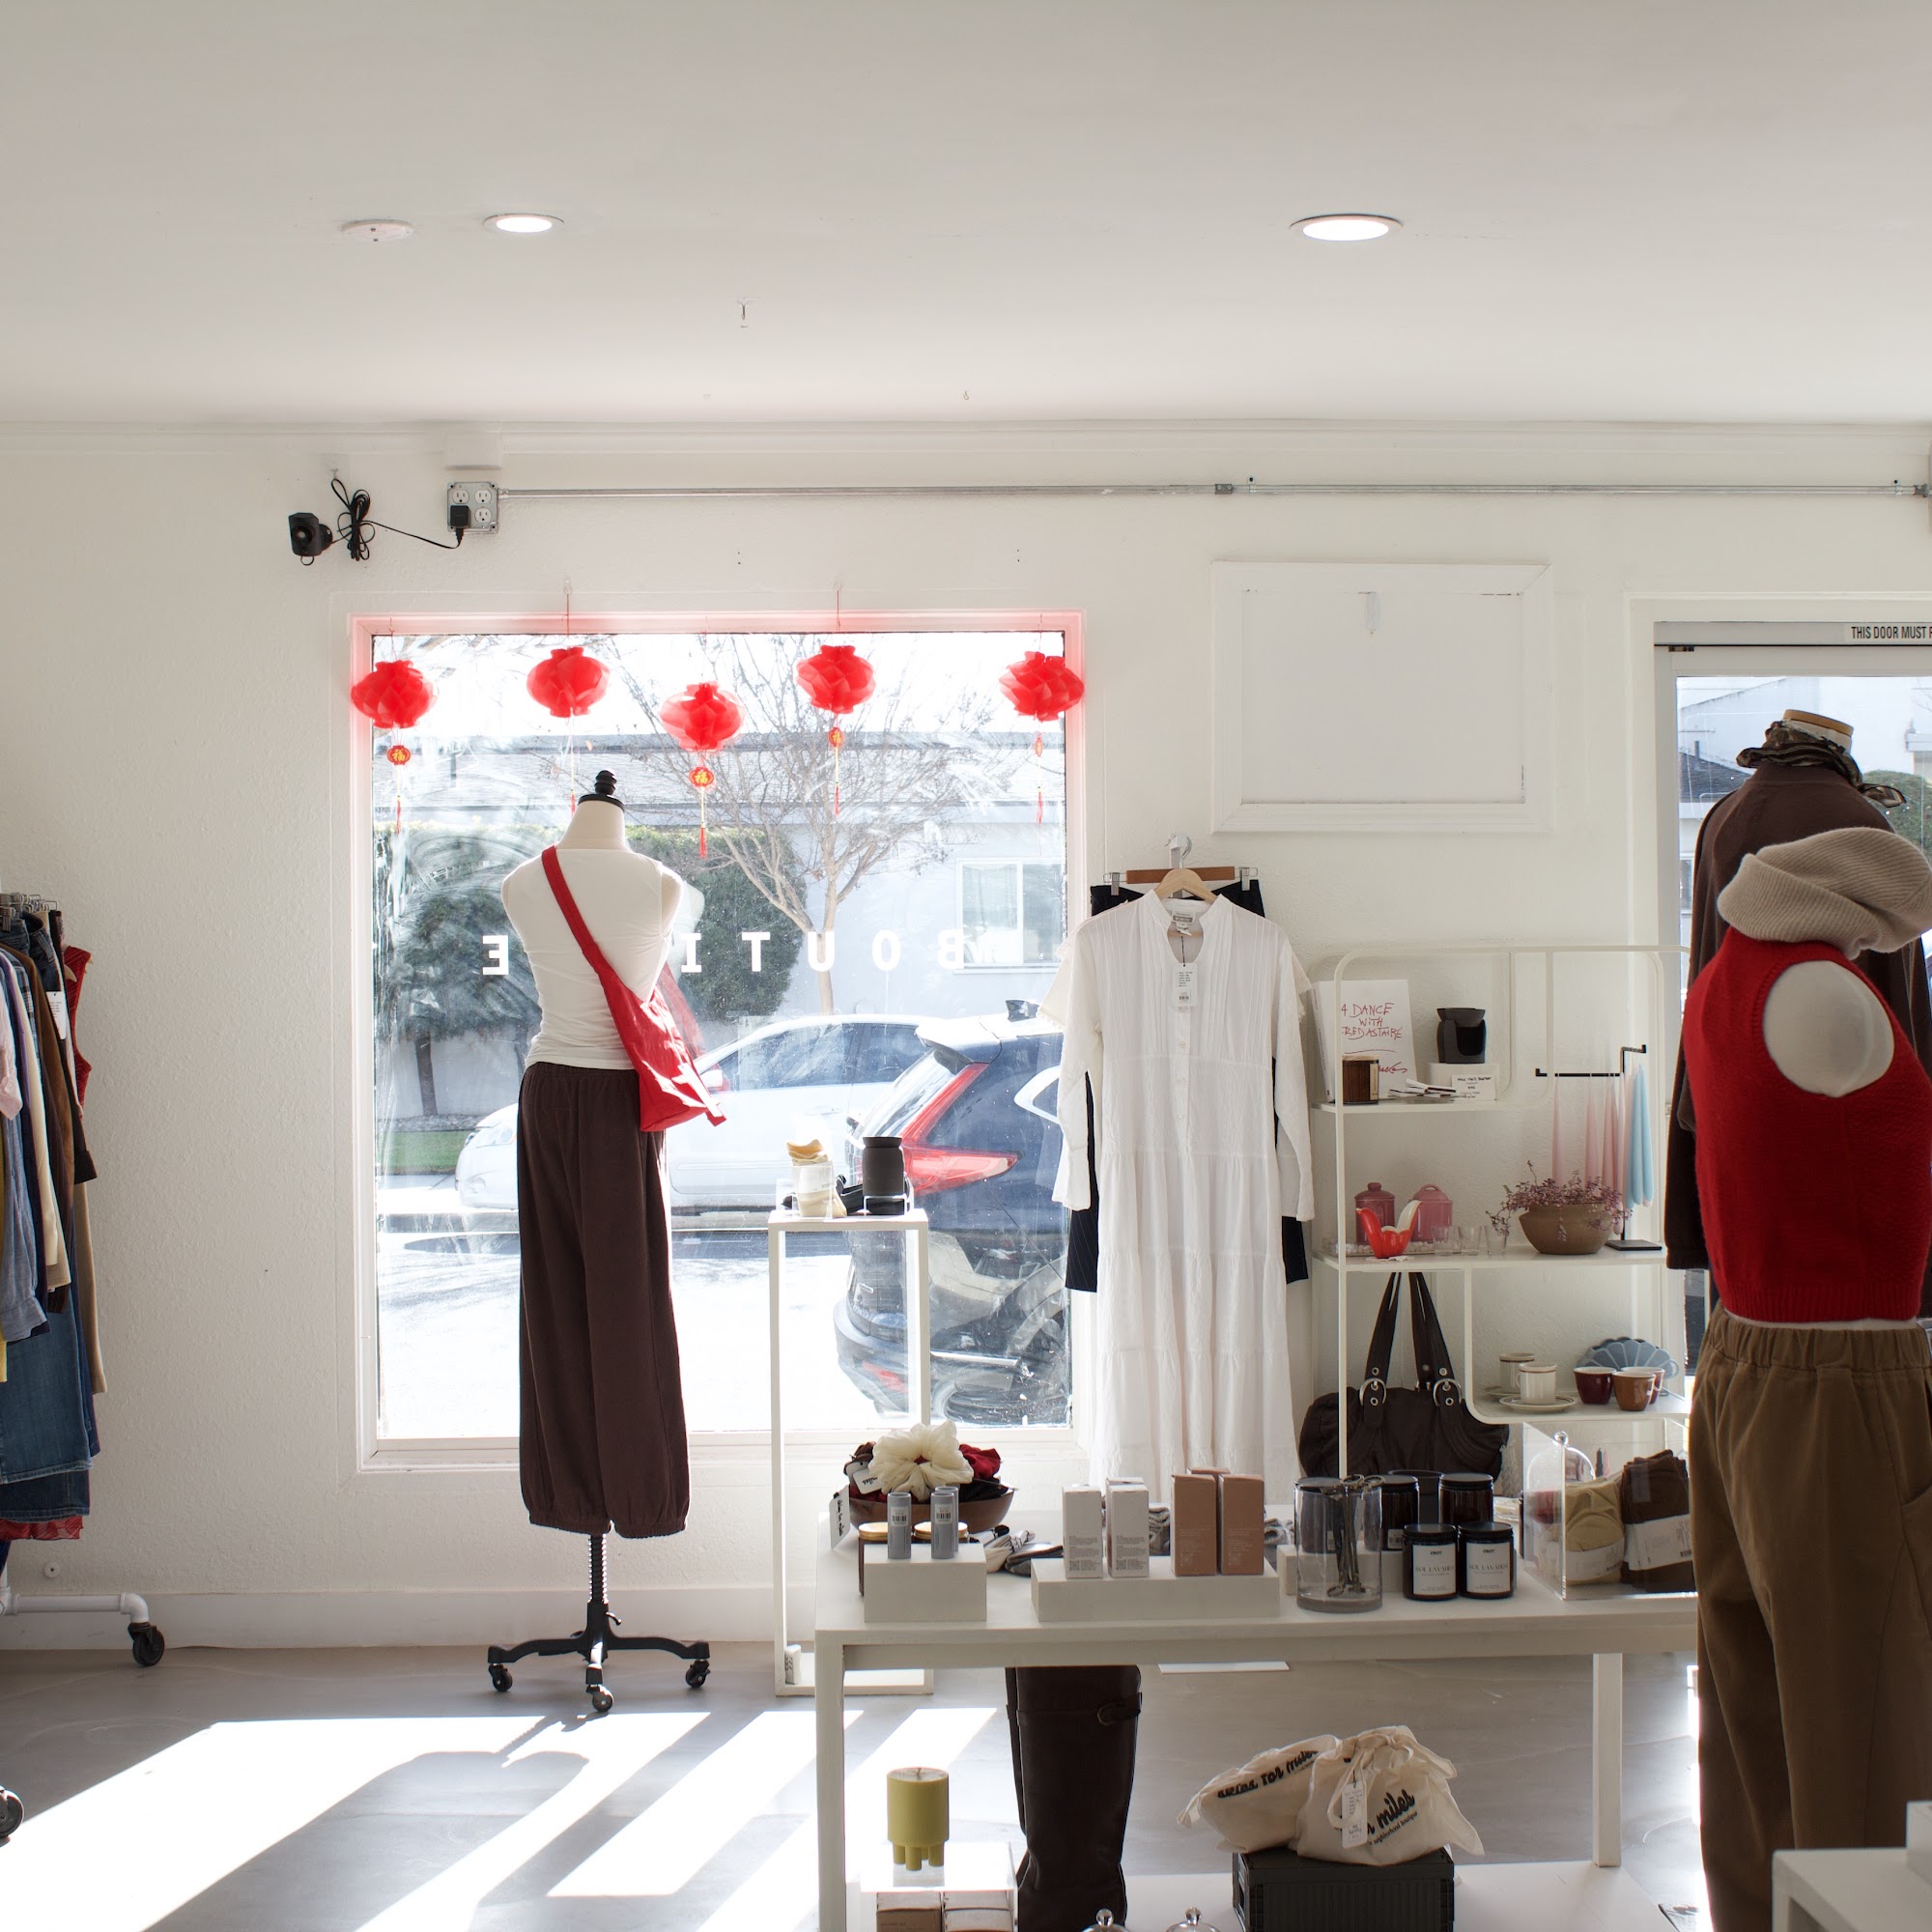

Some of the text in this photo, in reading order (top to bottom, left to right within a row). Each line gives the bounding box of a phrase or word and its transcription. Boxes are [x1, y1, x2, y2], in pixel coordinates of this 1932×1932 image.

[1851, 626, 1871, 639] THIS
[1874, 626, 1898, 639] DOOR
[1901, 626, 1926, 639] MUST
[1350, 1003, 1394, 1017] DANCE
[1376, 1788, 1415, 1830] miles
